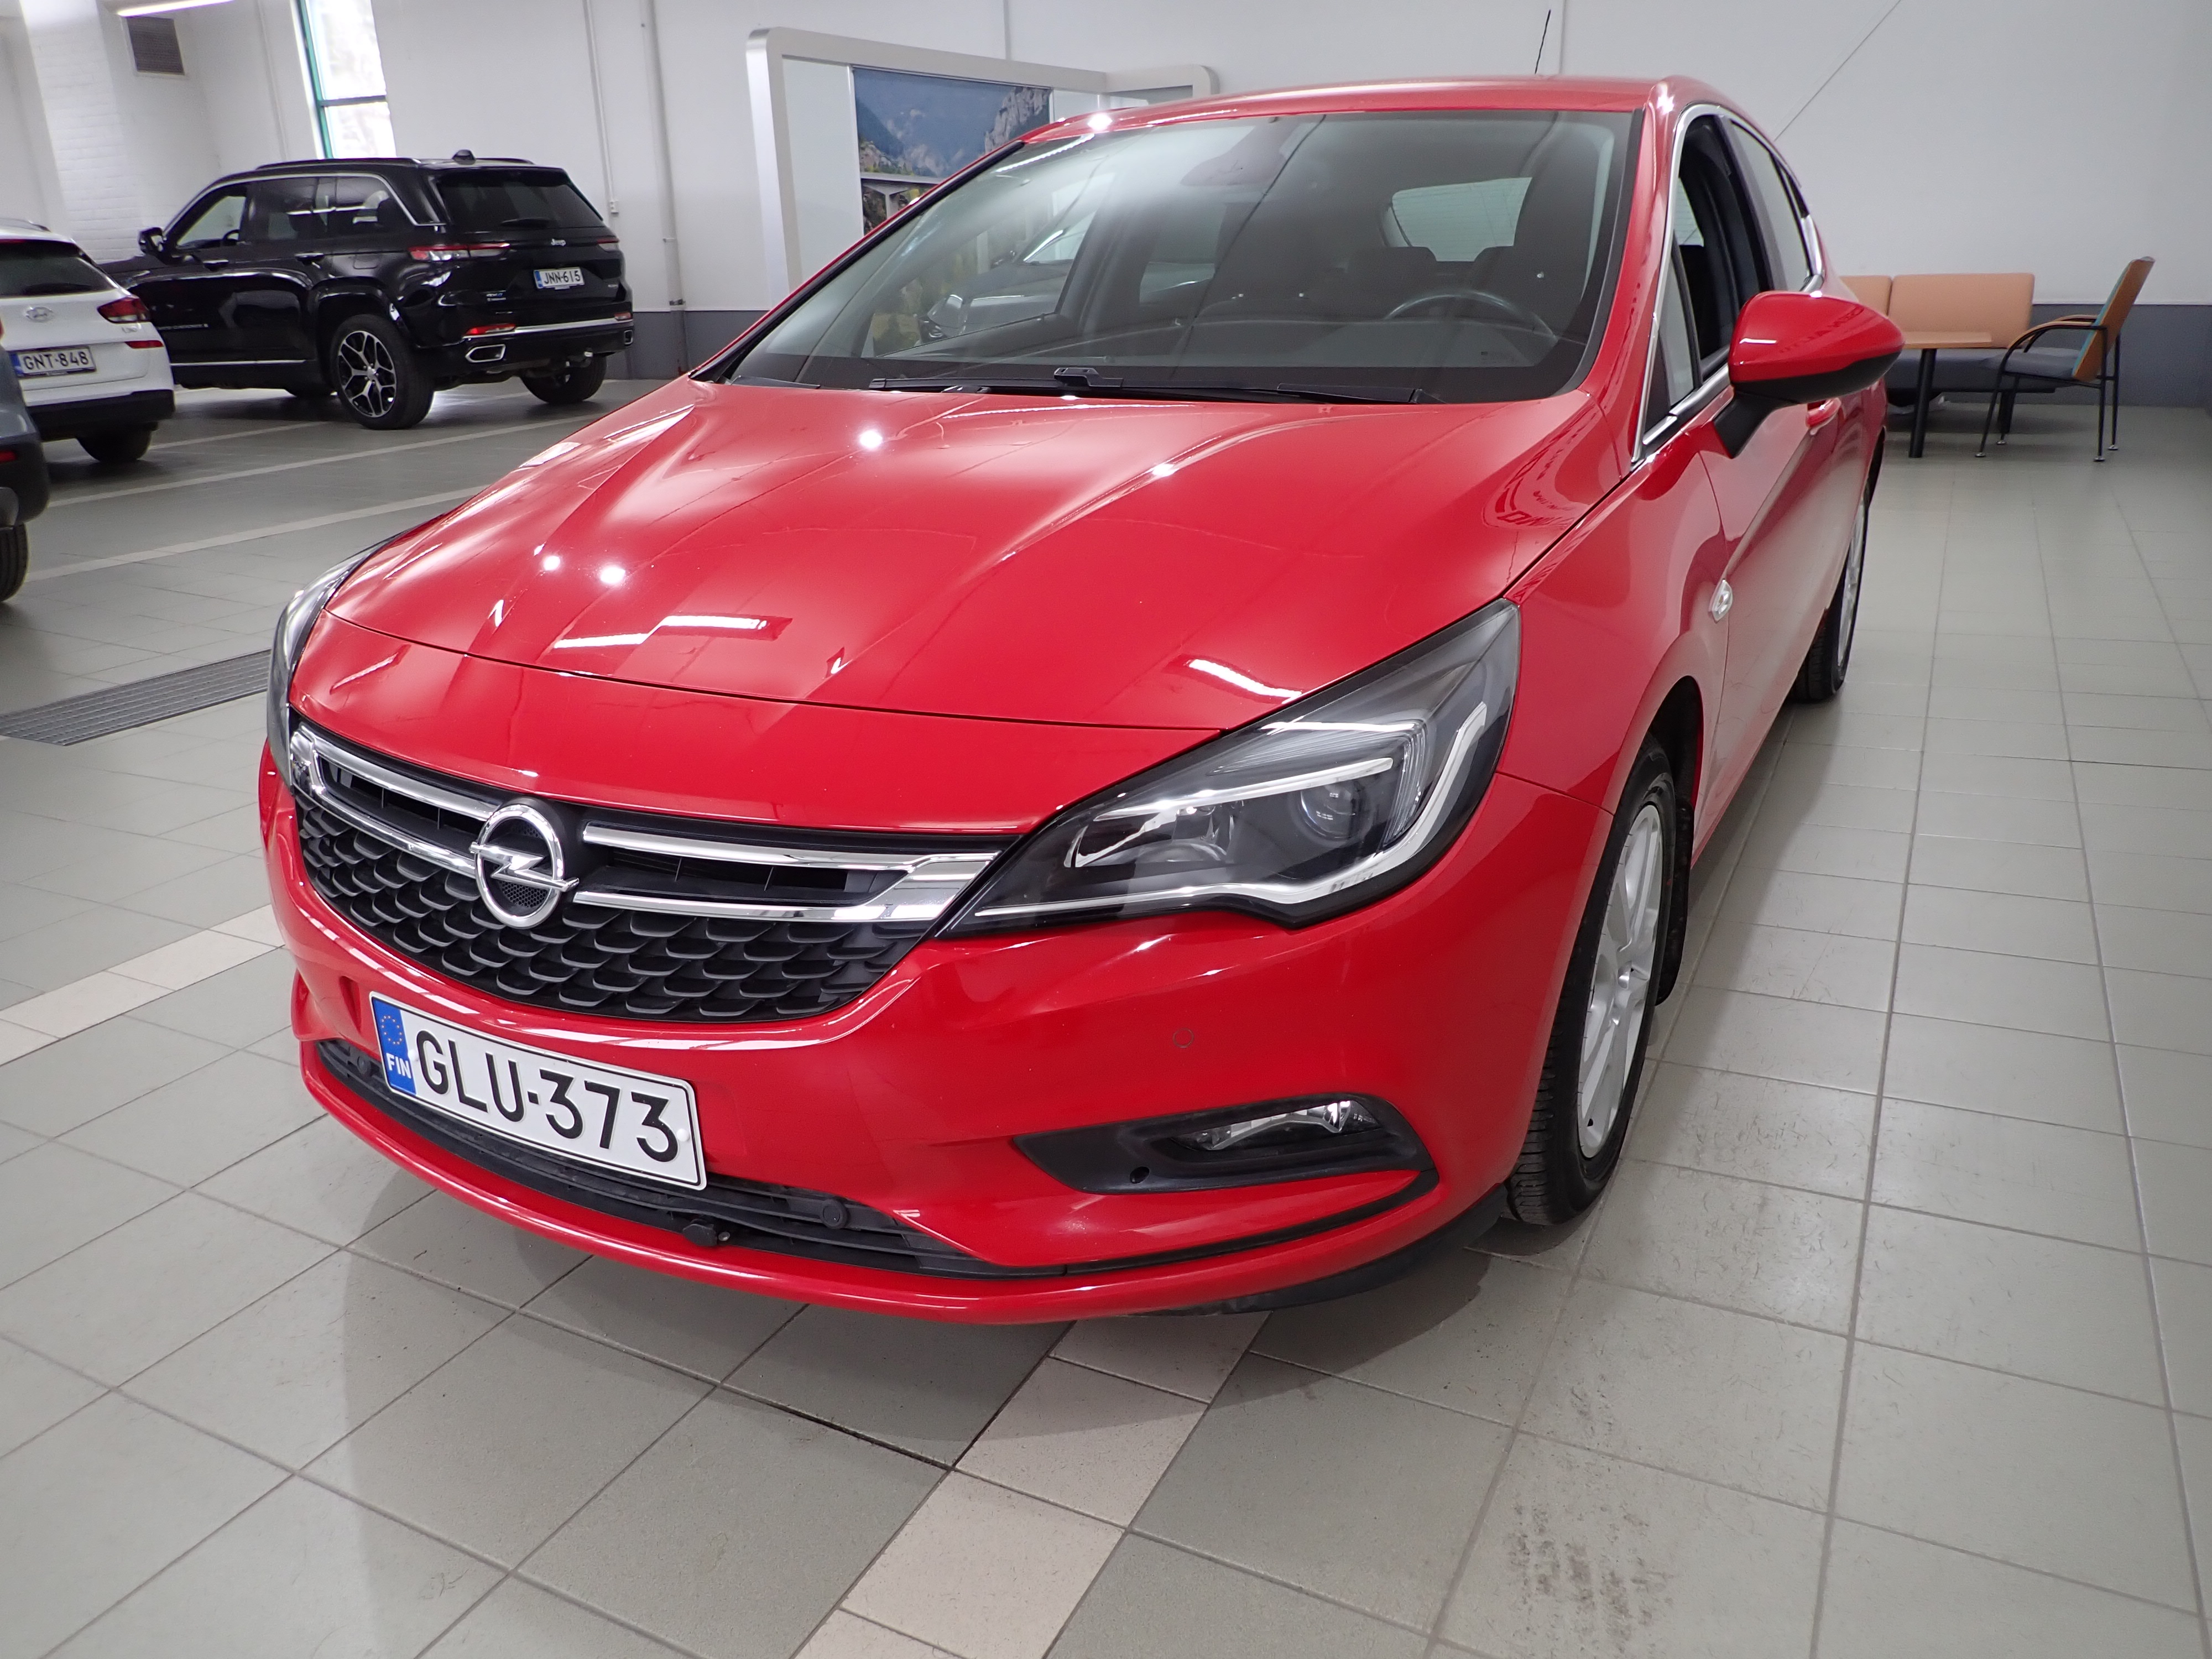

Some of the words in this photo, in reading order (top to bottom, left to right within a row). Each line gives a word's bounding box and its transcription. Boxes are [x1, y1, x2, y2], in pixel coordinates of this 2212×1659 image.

[544, 270, 581, 284] JNN-615
[23, 351, 88, 370] GNT-848
[386, 1053, 411, 1079] FIN
[416, 1030, 678, 1162] GLU-373
